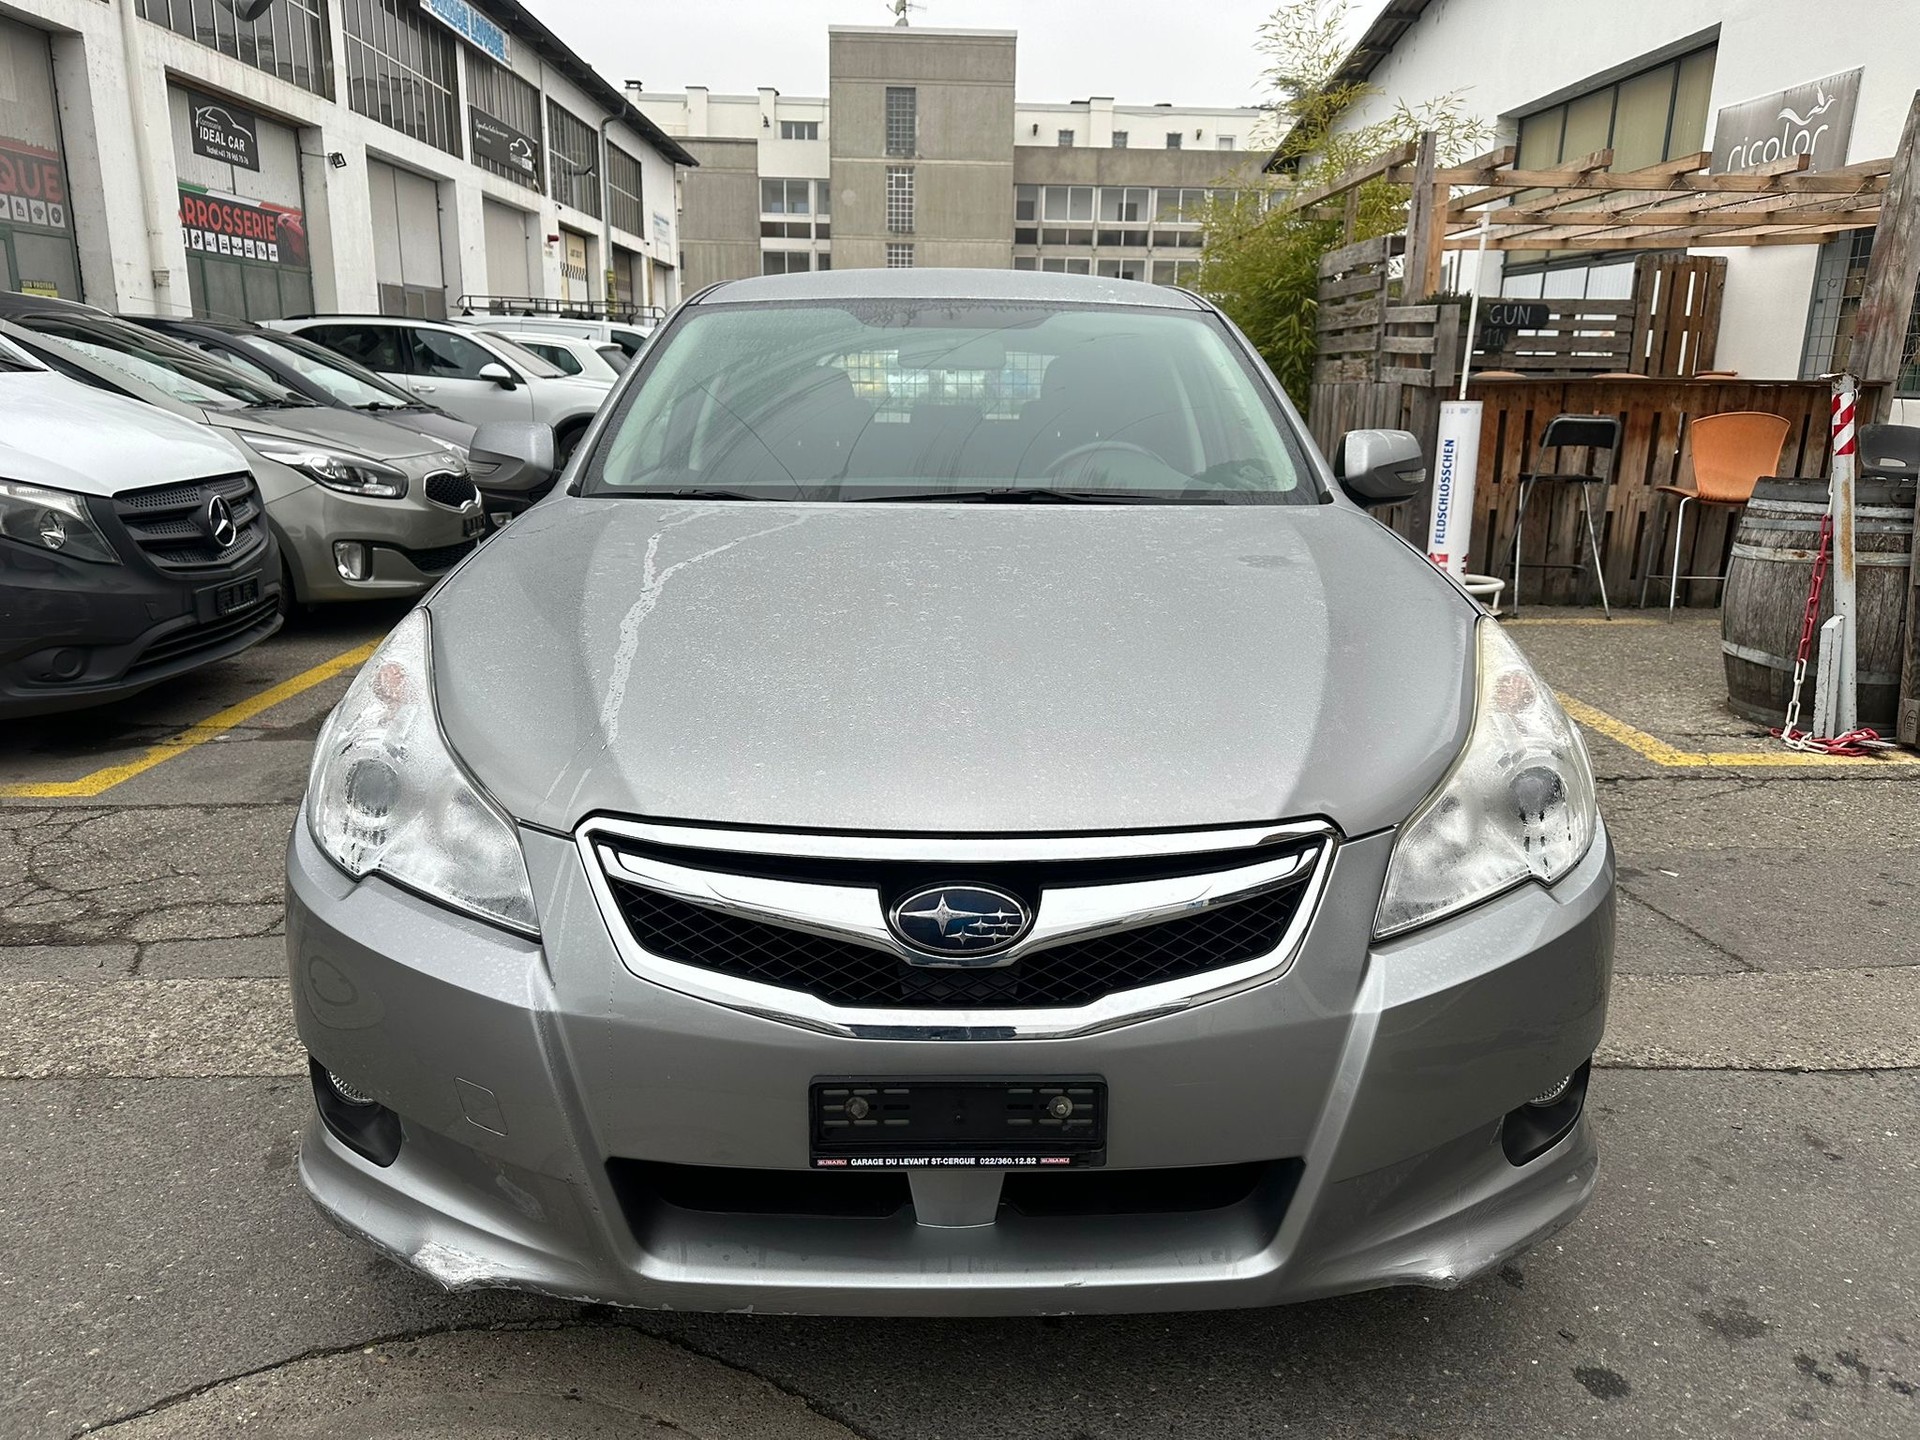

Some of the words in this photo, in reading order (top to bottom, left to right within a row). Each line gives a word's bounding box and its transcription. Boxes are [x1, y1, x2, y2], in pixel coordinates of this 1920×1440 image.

[200, 126, 227, 146] IDEAL
[228, 135, 245, 152] CAR
[1726, 122, 1829, 172] ricolor
[1490, 304, 1531, 325] GUN
[1434, 439, 1455, 545] FELDSCHLÖSSCHEN
[850, 1158, 884, 1166] GARAGE
[885, 1158, 898, 1166] DU
[899, 1157, 930, 1165] LEVANT
[931, 1157, 976, 1165] ST-CERGUE
[979, 1157, 1037, 1165] 022/360.12.82
